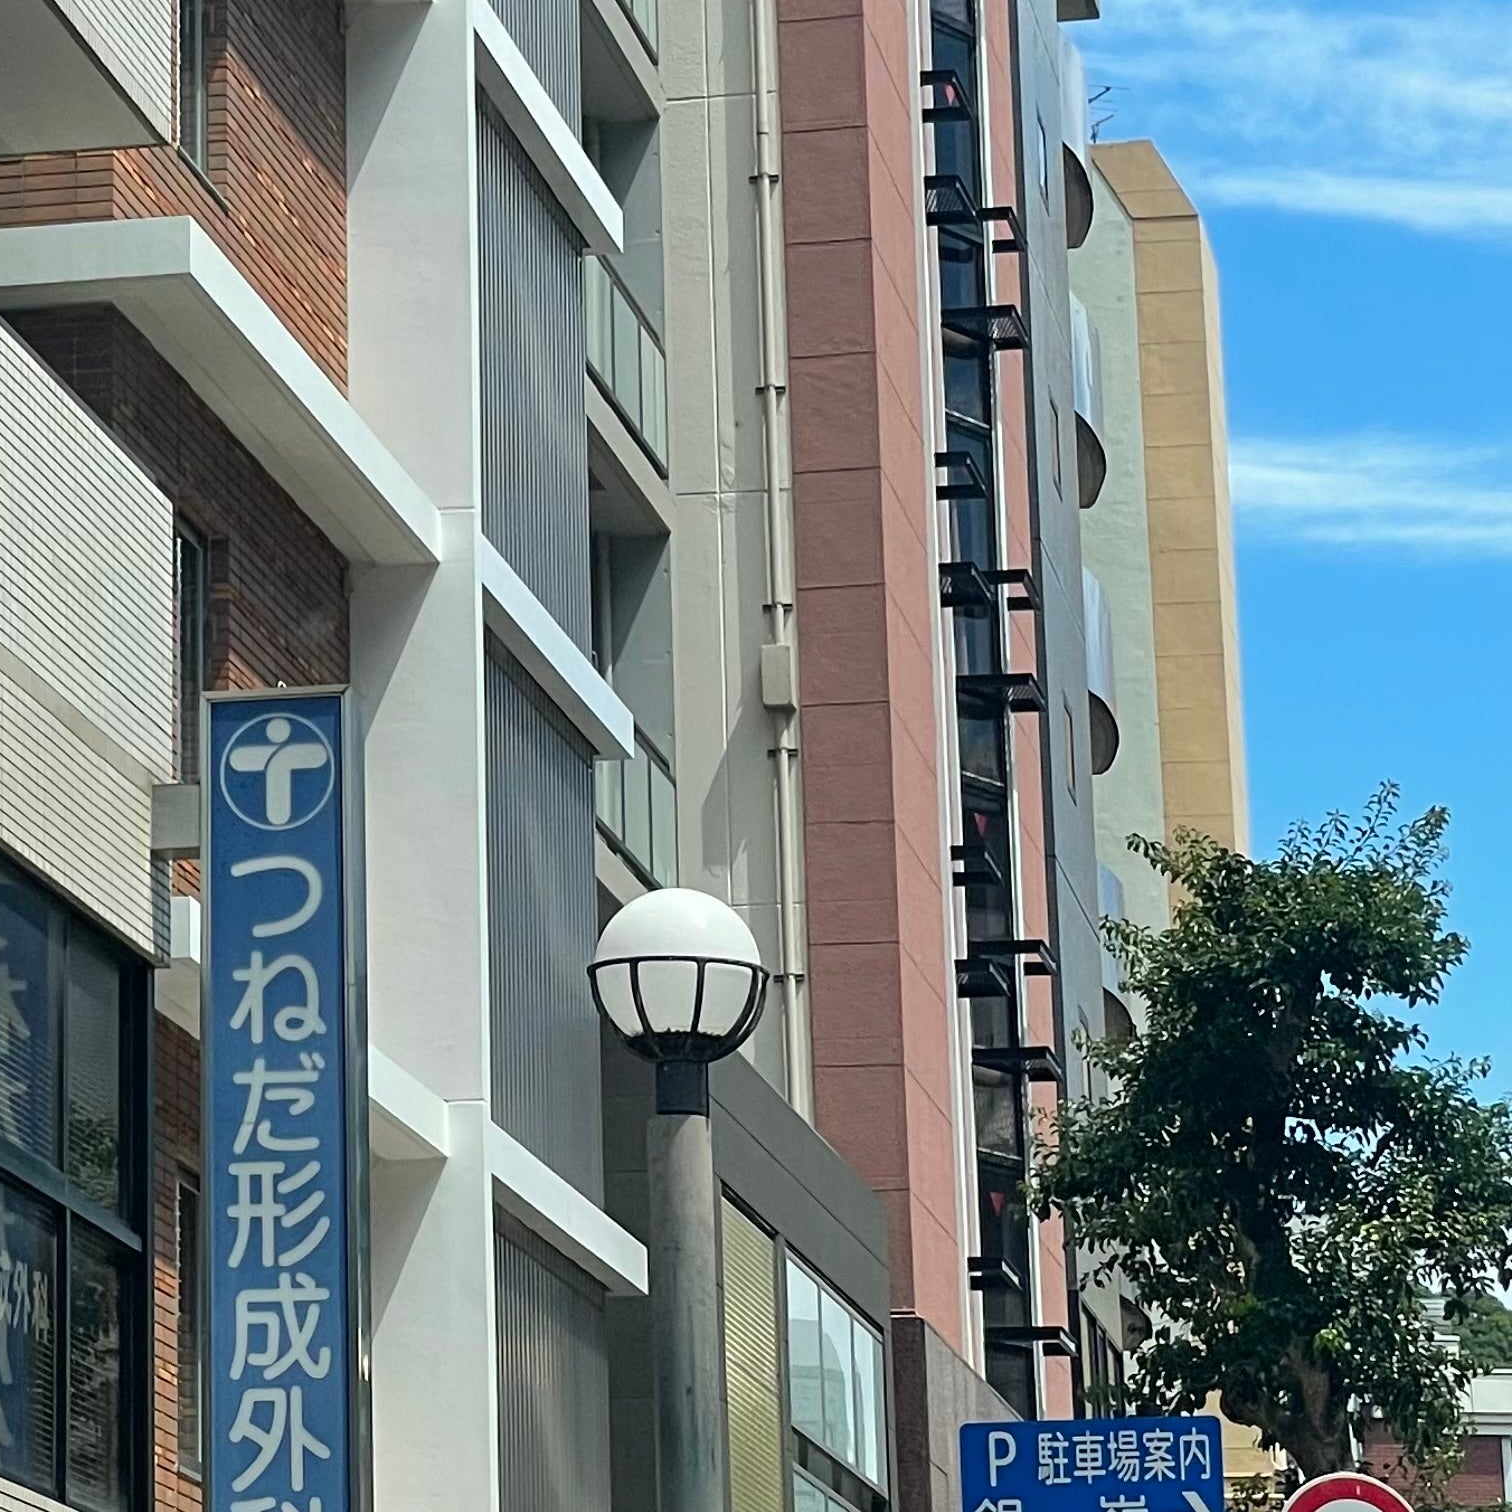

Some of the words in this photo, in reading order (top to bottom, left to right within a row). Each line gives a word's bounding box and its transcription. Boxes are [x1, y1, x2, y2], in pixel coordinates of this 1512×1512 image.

[227, 855, 331, 1512] つねだ形成外
[988, 1431, 1017, 1487] P
[1038, 1427, 1211, 1485] 駐車場案内
